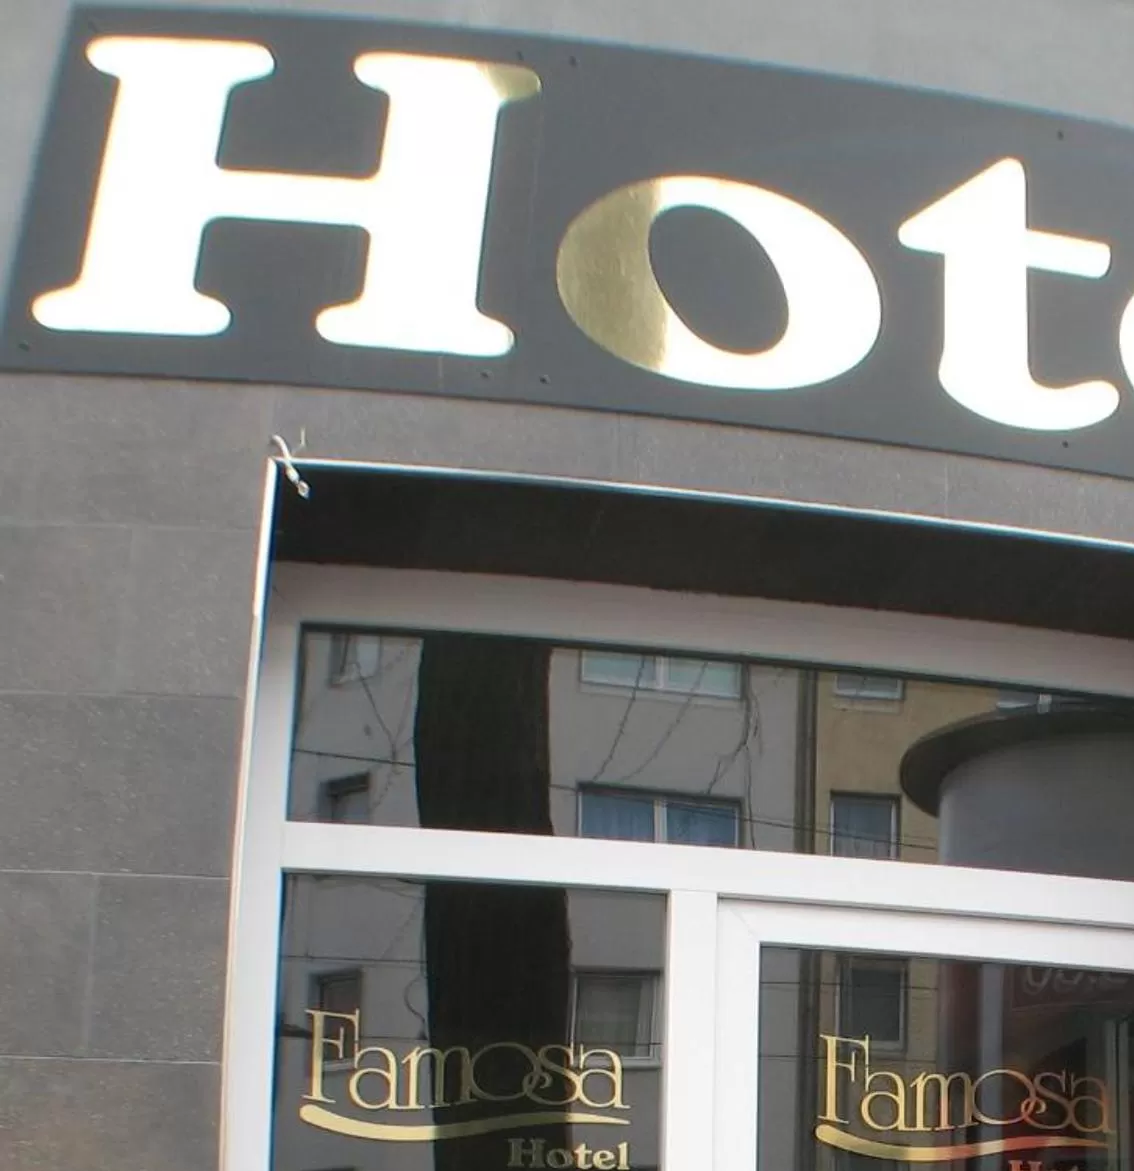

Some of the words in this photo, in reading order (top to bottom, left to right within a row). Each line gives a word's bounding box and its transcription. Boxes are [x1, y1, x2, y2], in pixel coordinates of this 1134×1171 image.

[302, 1008, 631, 1110] Famosa
[817, 1033, 1115, 1133] Famosa
[507, 1138, 631, 1171] Hotel
